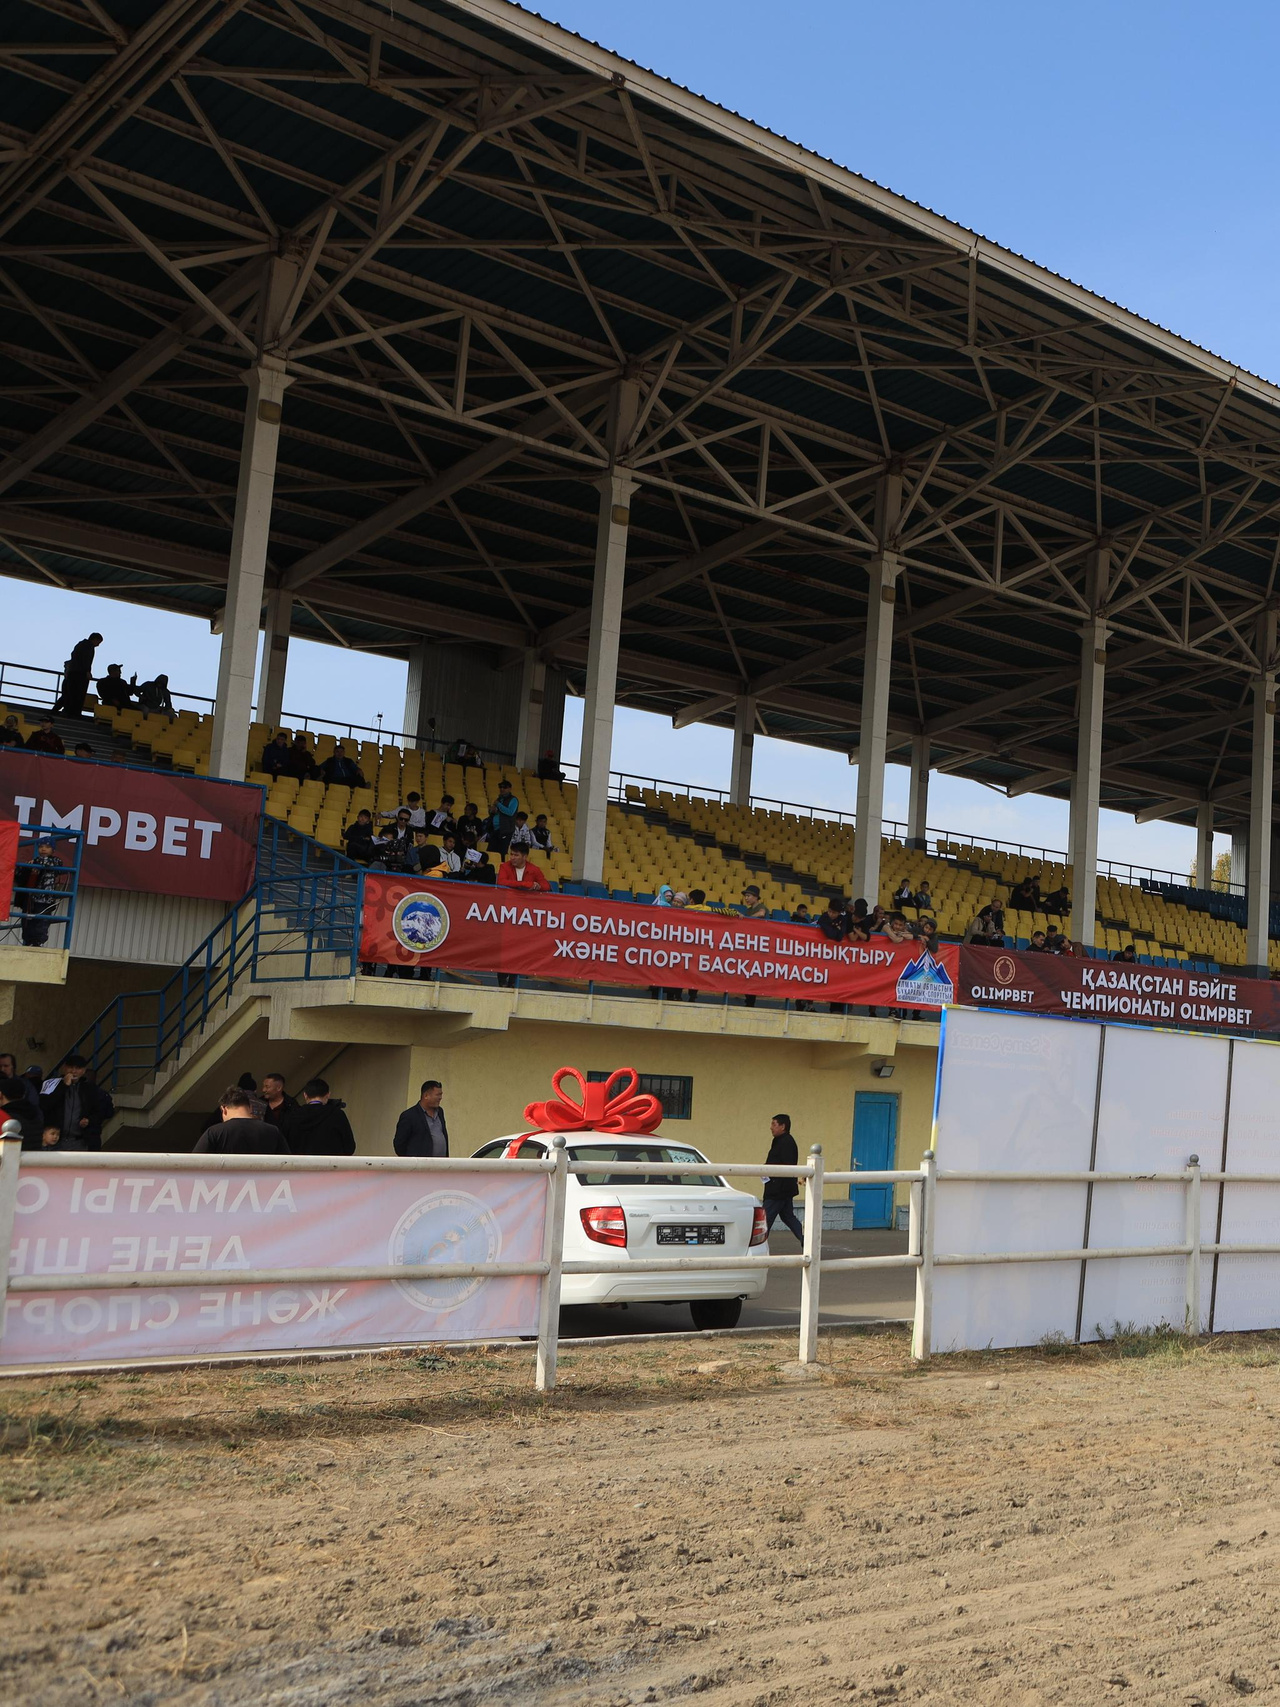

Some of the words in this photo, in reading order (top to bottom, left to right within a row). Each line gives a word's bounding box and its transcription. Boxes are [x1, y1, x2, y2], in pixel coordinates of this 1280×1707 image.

[14, 795, 222, 859] IMPBET
[465, 902, 565, 930] АЛМАТЫ
[572, 913, 714, 948] ОБЛЫСЫНЫҢ
[718, 931, 770, 953] ДЕНЕ
[775, 937, 895, 967] ШЫНЫҚТЫРУ
[553, 939, 619, 963] ЖӘНЕ
[625, 946, 693, 970] СПОРТ
[698, 954, 829, 985] БАСҚАРМАСЫ
[971, 985, 1035, 1004] OLIMPBET
[1081, 967, 1183, 997] ҚАЗАҚСТАН
[1188, 977, 1237, 1001] БӘЙГЕ
[1060, 990, 1175, 1018] ЧЕМПИОНАТЫ
[1180, 1006, 1252, 1025] OLIMPBET
